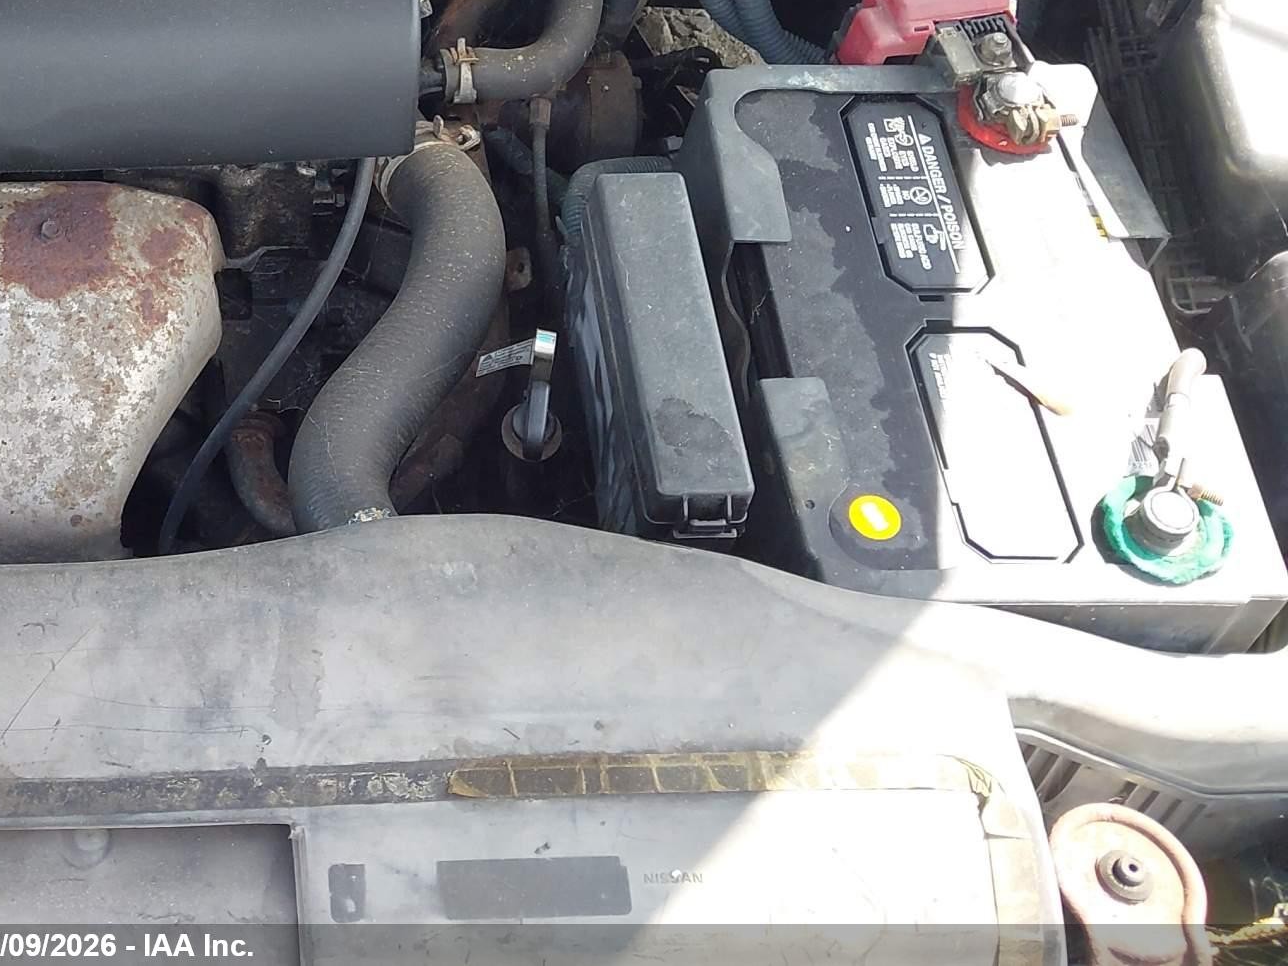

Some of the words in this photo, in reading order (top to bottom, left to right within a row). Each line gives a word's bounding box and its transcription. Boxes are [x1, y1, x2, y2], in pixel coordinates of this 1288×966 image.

[921, 145, 947, 194] DANGER
[940, 202, 965, 250] POISON
[642, 871, 703, 884] NISSAN
